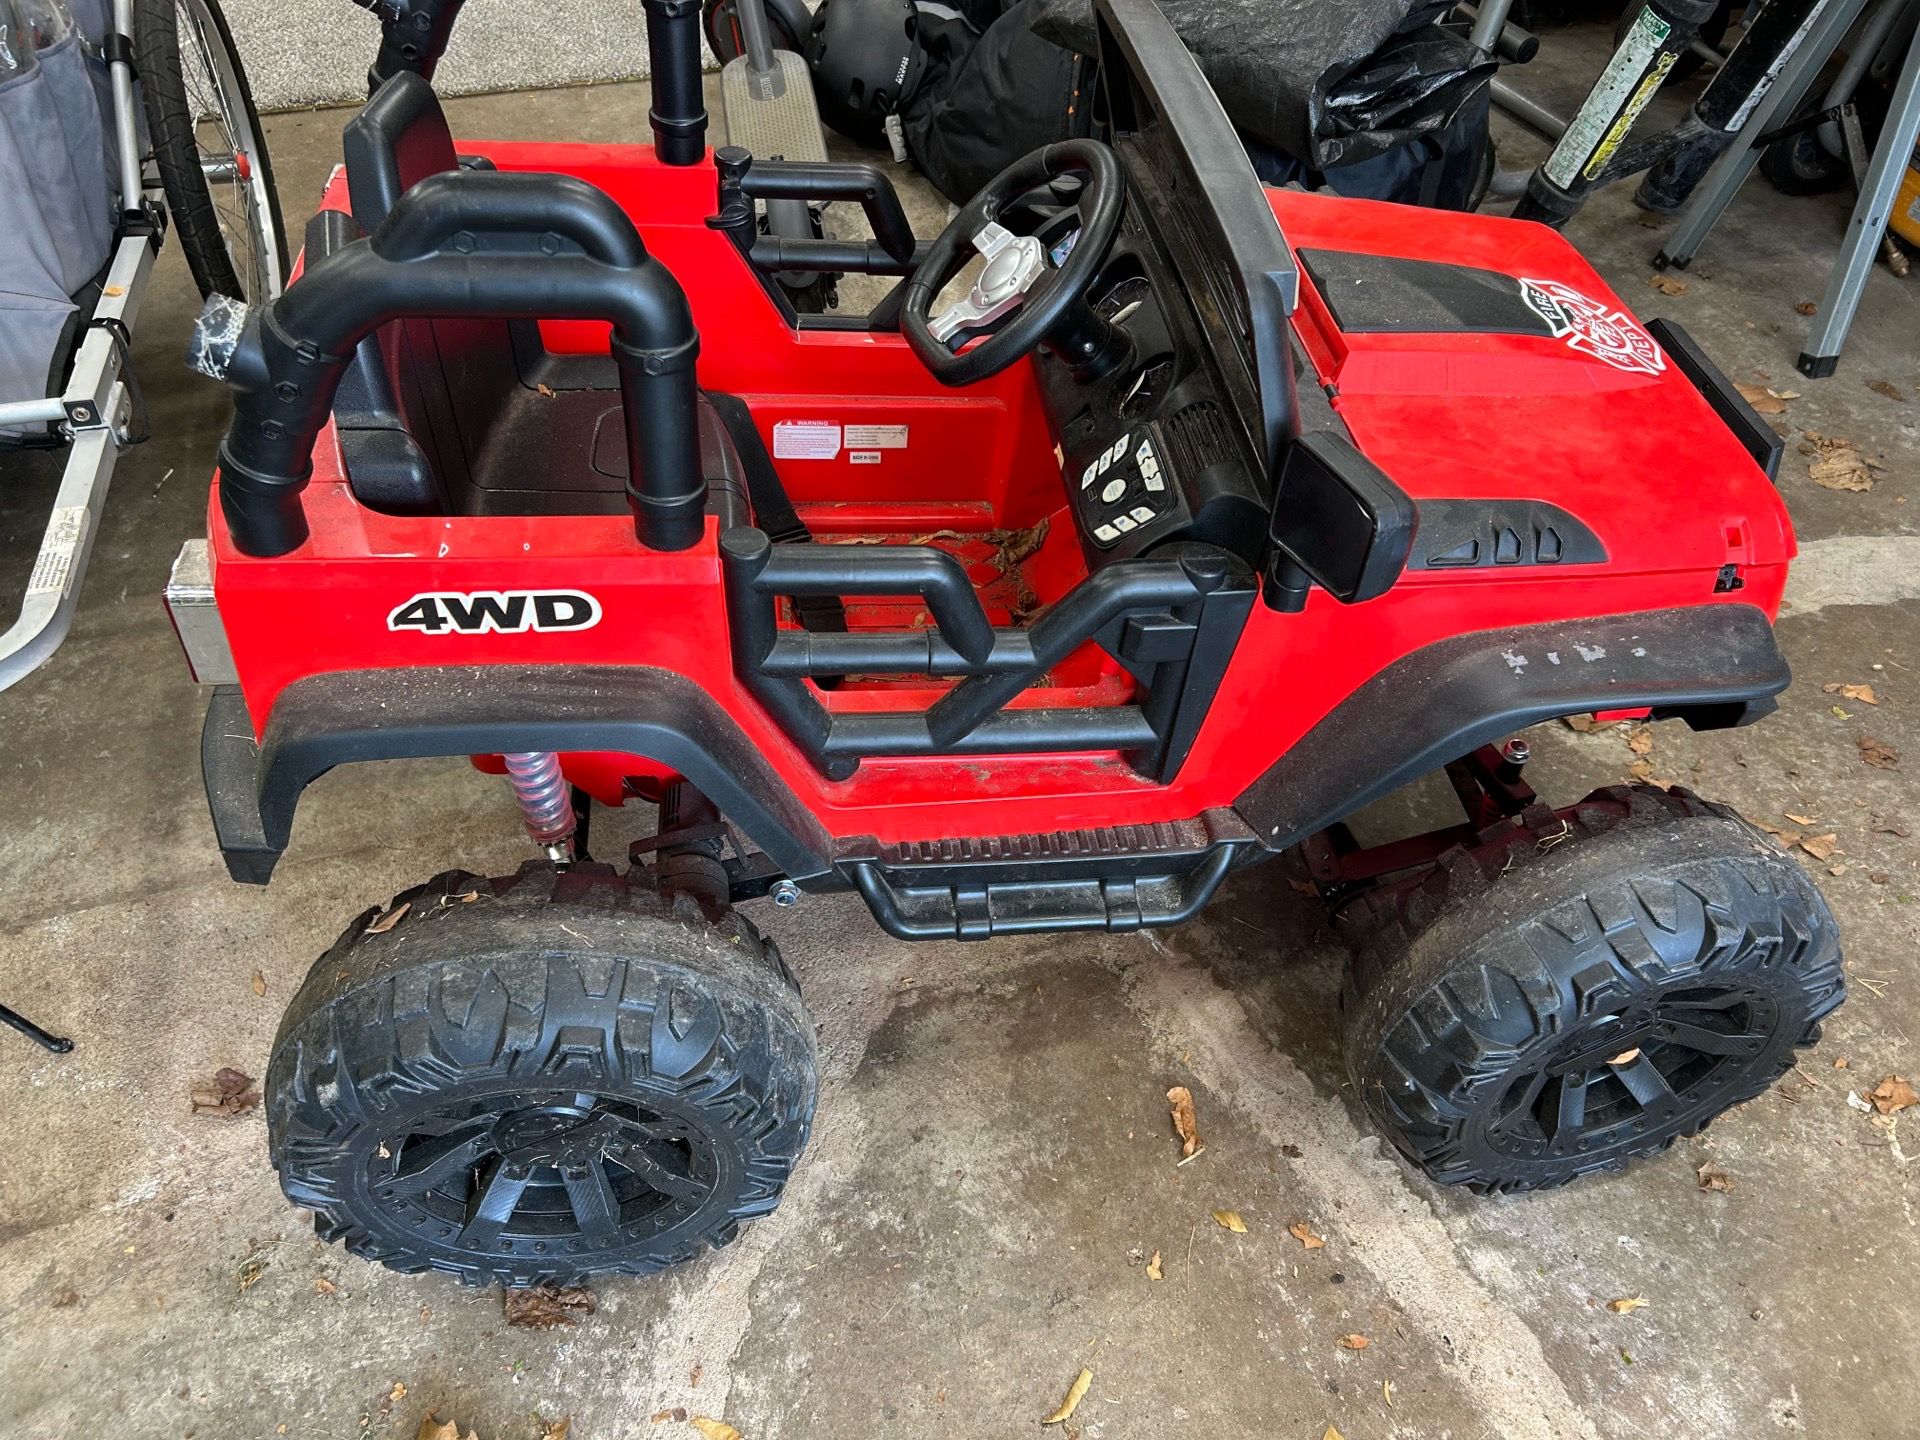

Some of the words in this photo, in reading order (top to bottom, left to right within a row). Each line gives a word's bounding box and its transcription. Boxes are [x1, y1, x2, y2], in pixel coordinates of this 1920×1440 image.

[1530, 290, 1562, 320] FIRE
[1615, 324, 1653, 358] DEPT
[391, 593, 596, 632] 4WD
